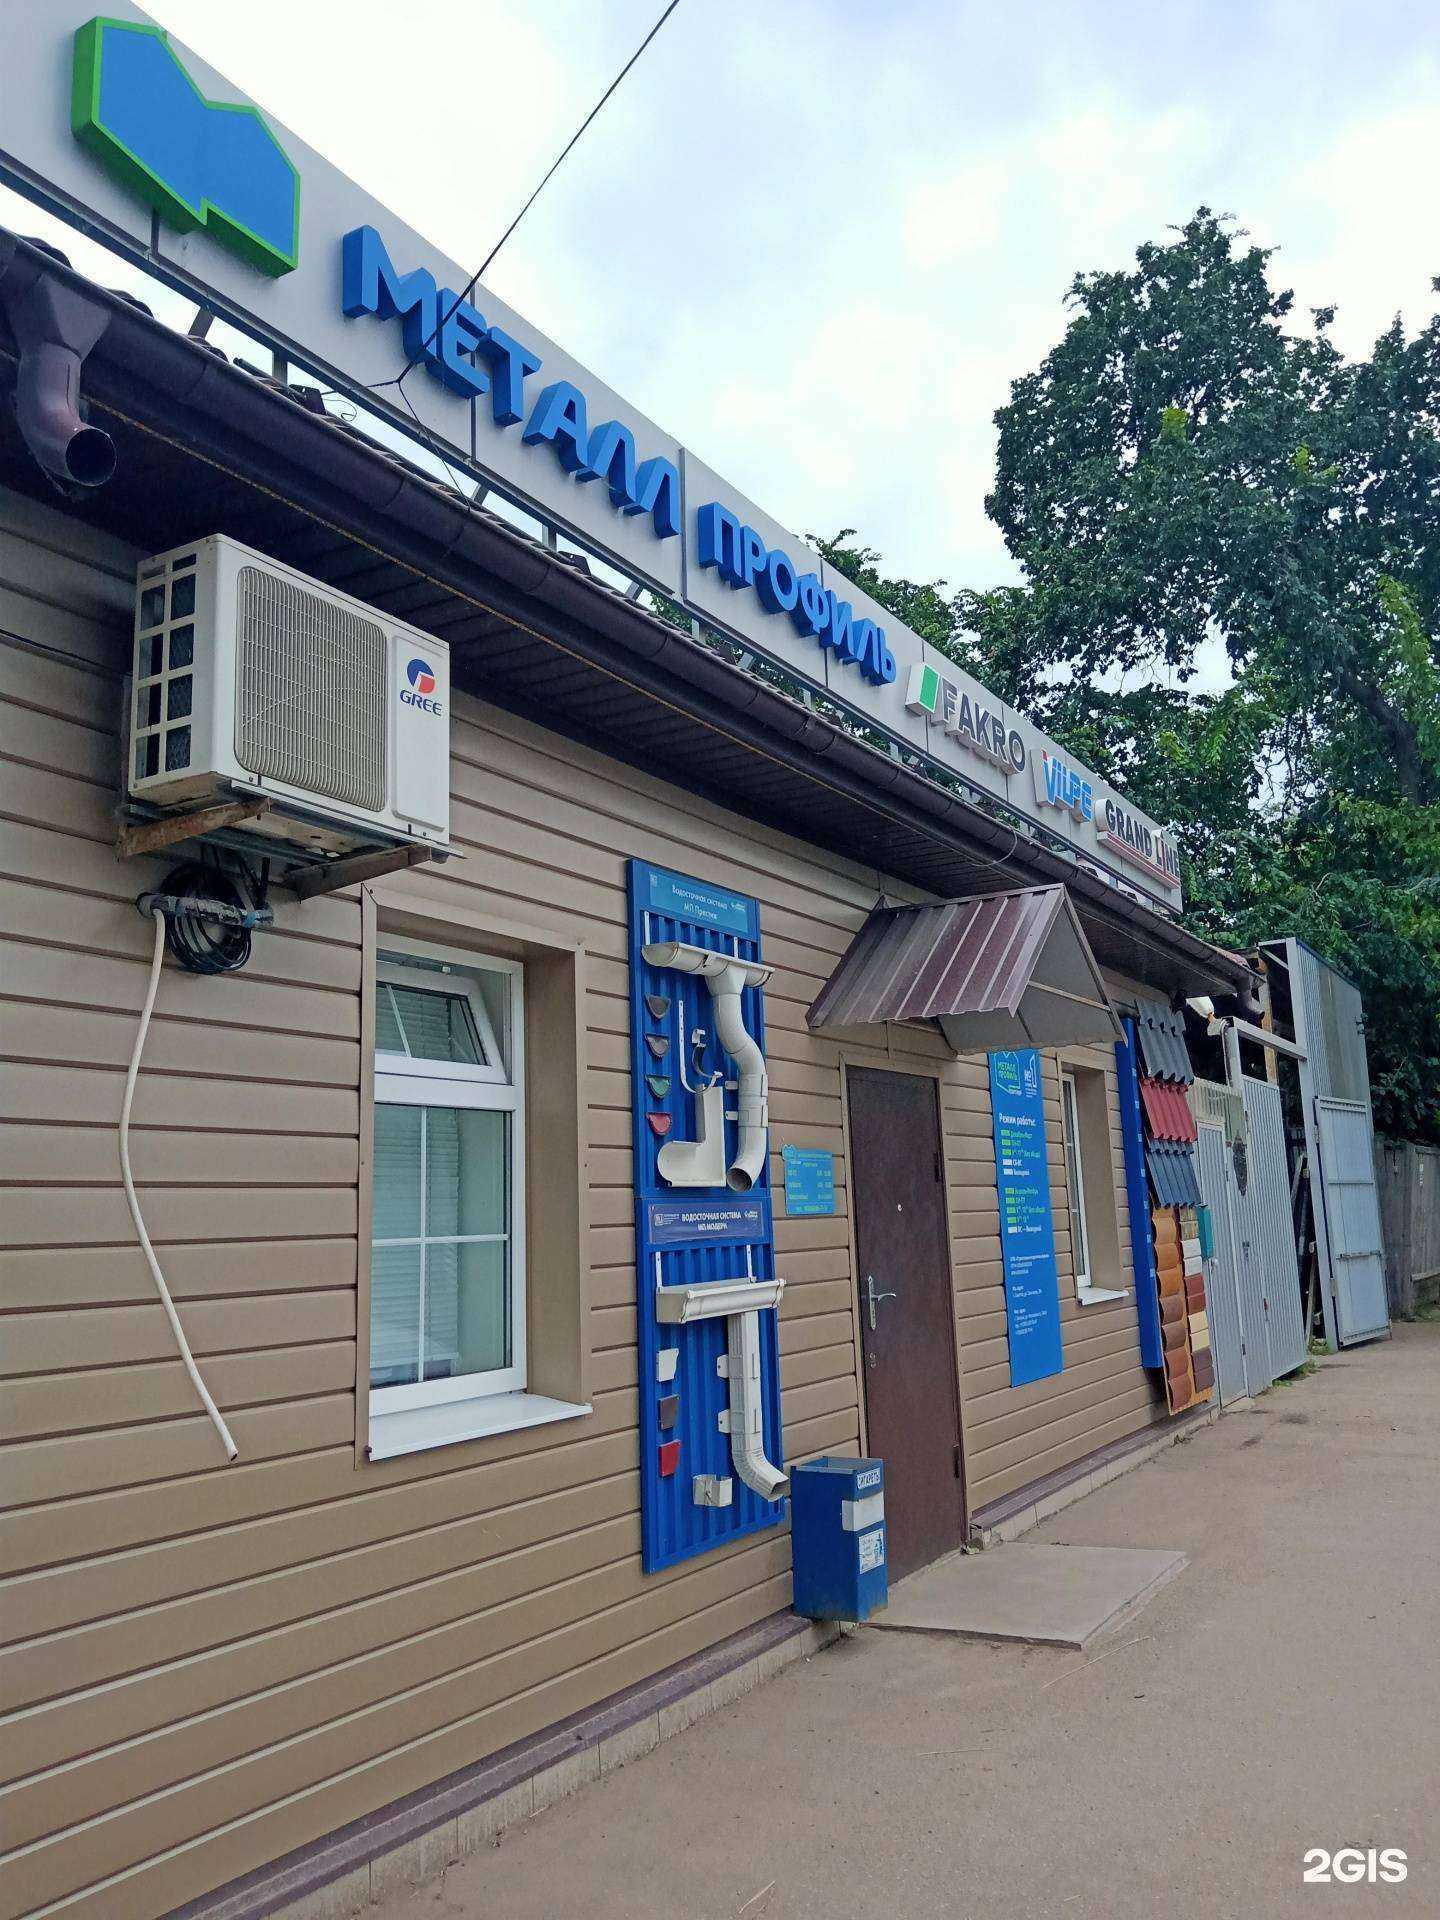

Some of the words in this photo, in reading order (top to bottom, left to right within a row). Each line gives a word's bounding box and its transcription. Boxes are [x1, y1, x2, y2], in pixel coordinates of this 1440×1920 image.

[342, 224, 681, 539] МЕТАЛЛ
[697, 502, 896, 686] ПРОФИЛЬ
[399, 689, 443, 717] GREE
[938, 675, 1026, 775] FAKRO
[1104, 799, 1153, 858] GRAND
